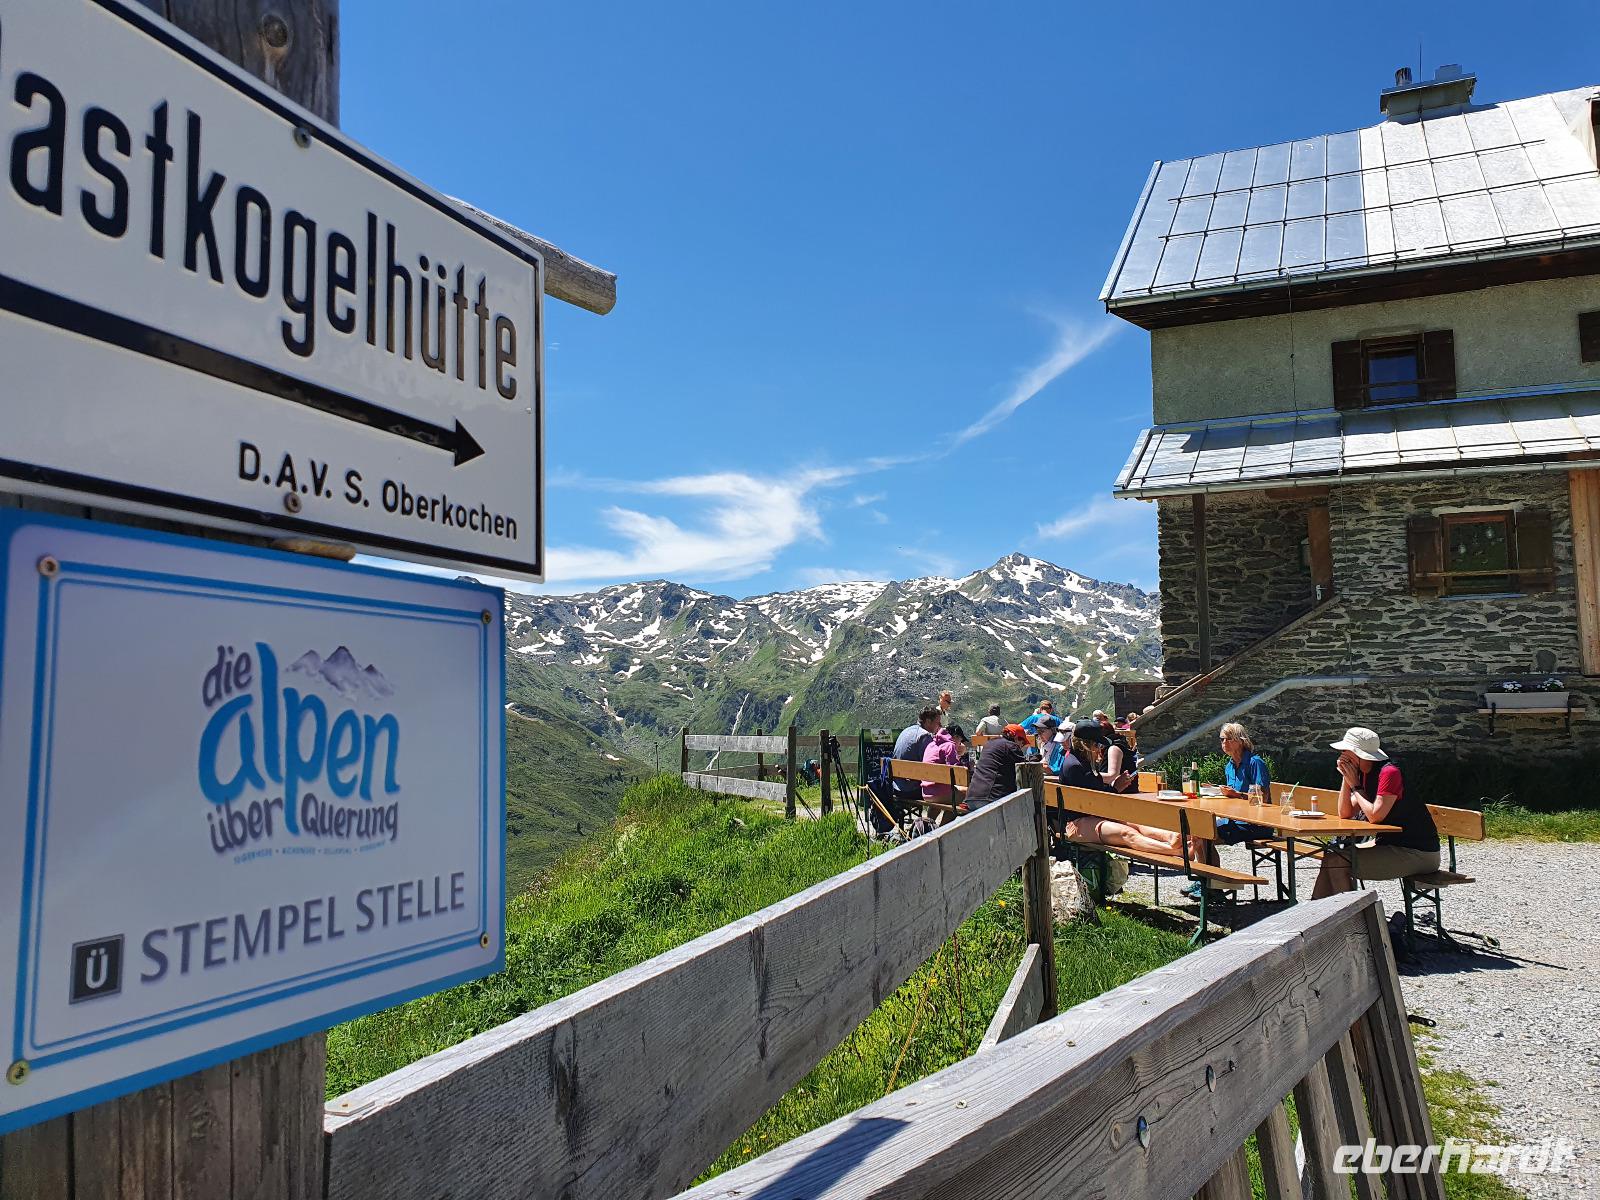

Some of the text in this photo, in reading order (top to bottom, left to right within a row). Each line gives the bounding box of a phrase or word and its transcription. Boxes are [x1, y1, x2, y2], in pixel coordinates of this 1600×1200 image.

[0, 17, 518, 400] astkogelhütte
[238, 441, 518, 540] D.A.V. S. Oberkochen
[202, 645, 252, 707] die
[198, 641, 400, 836] alpen
[207, 797, 283, 855] über
[301, 793, 399, 841] Querung
[140, 896, 345, 985] STEMPEL
[356, 872, 465, 932] STELLE
